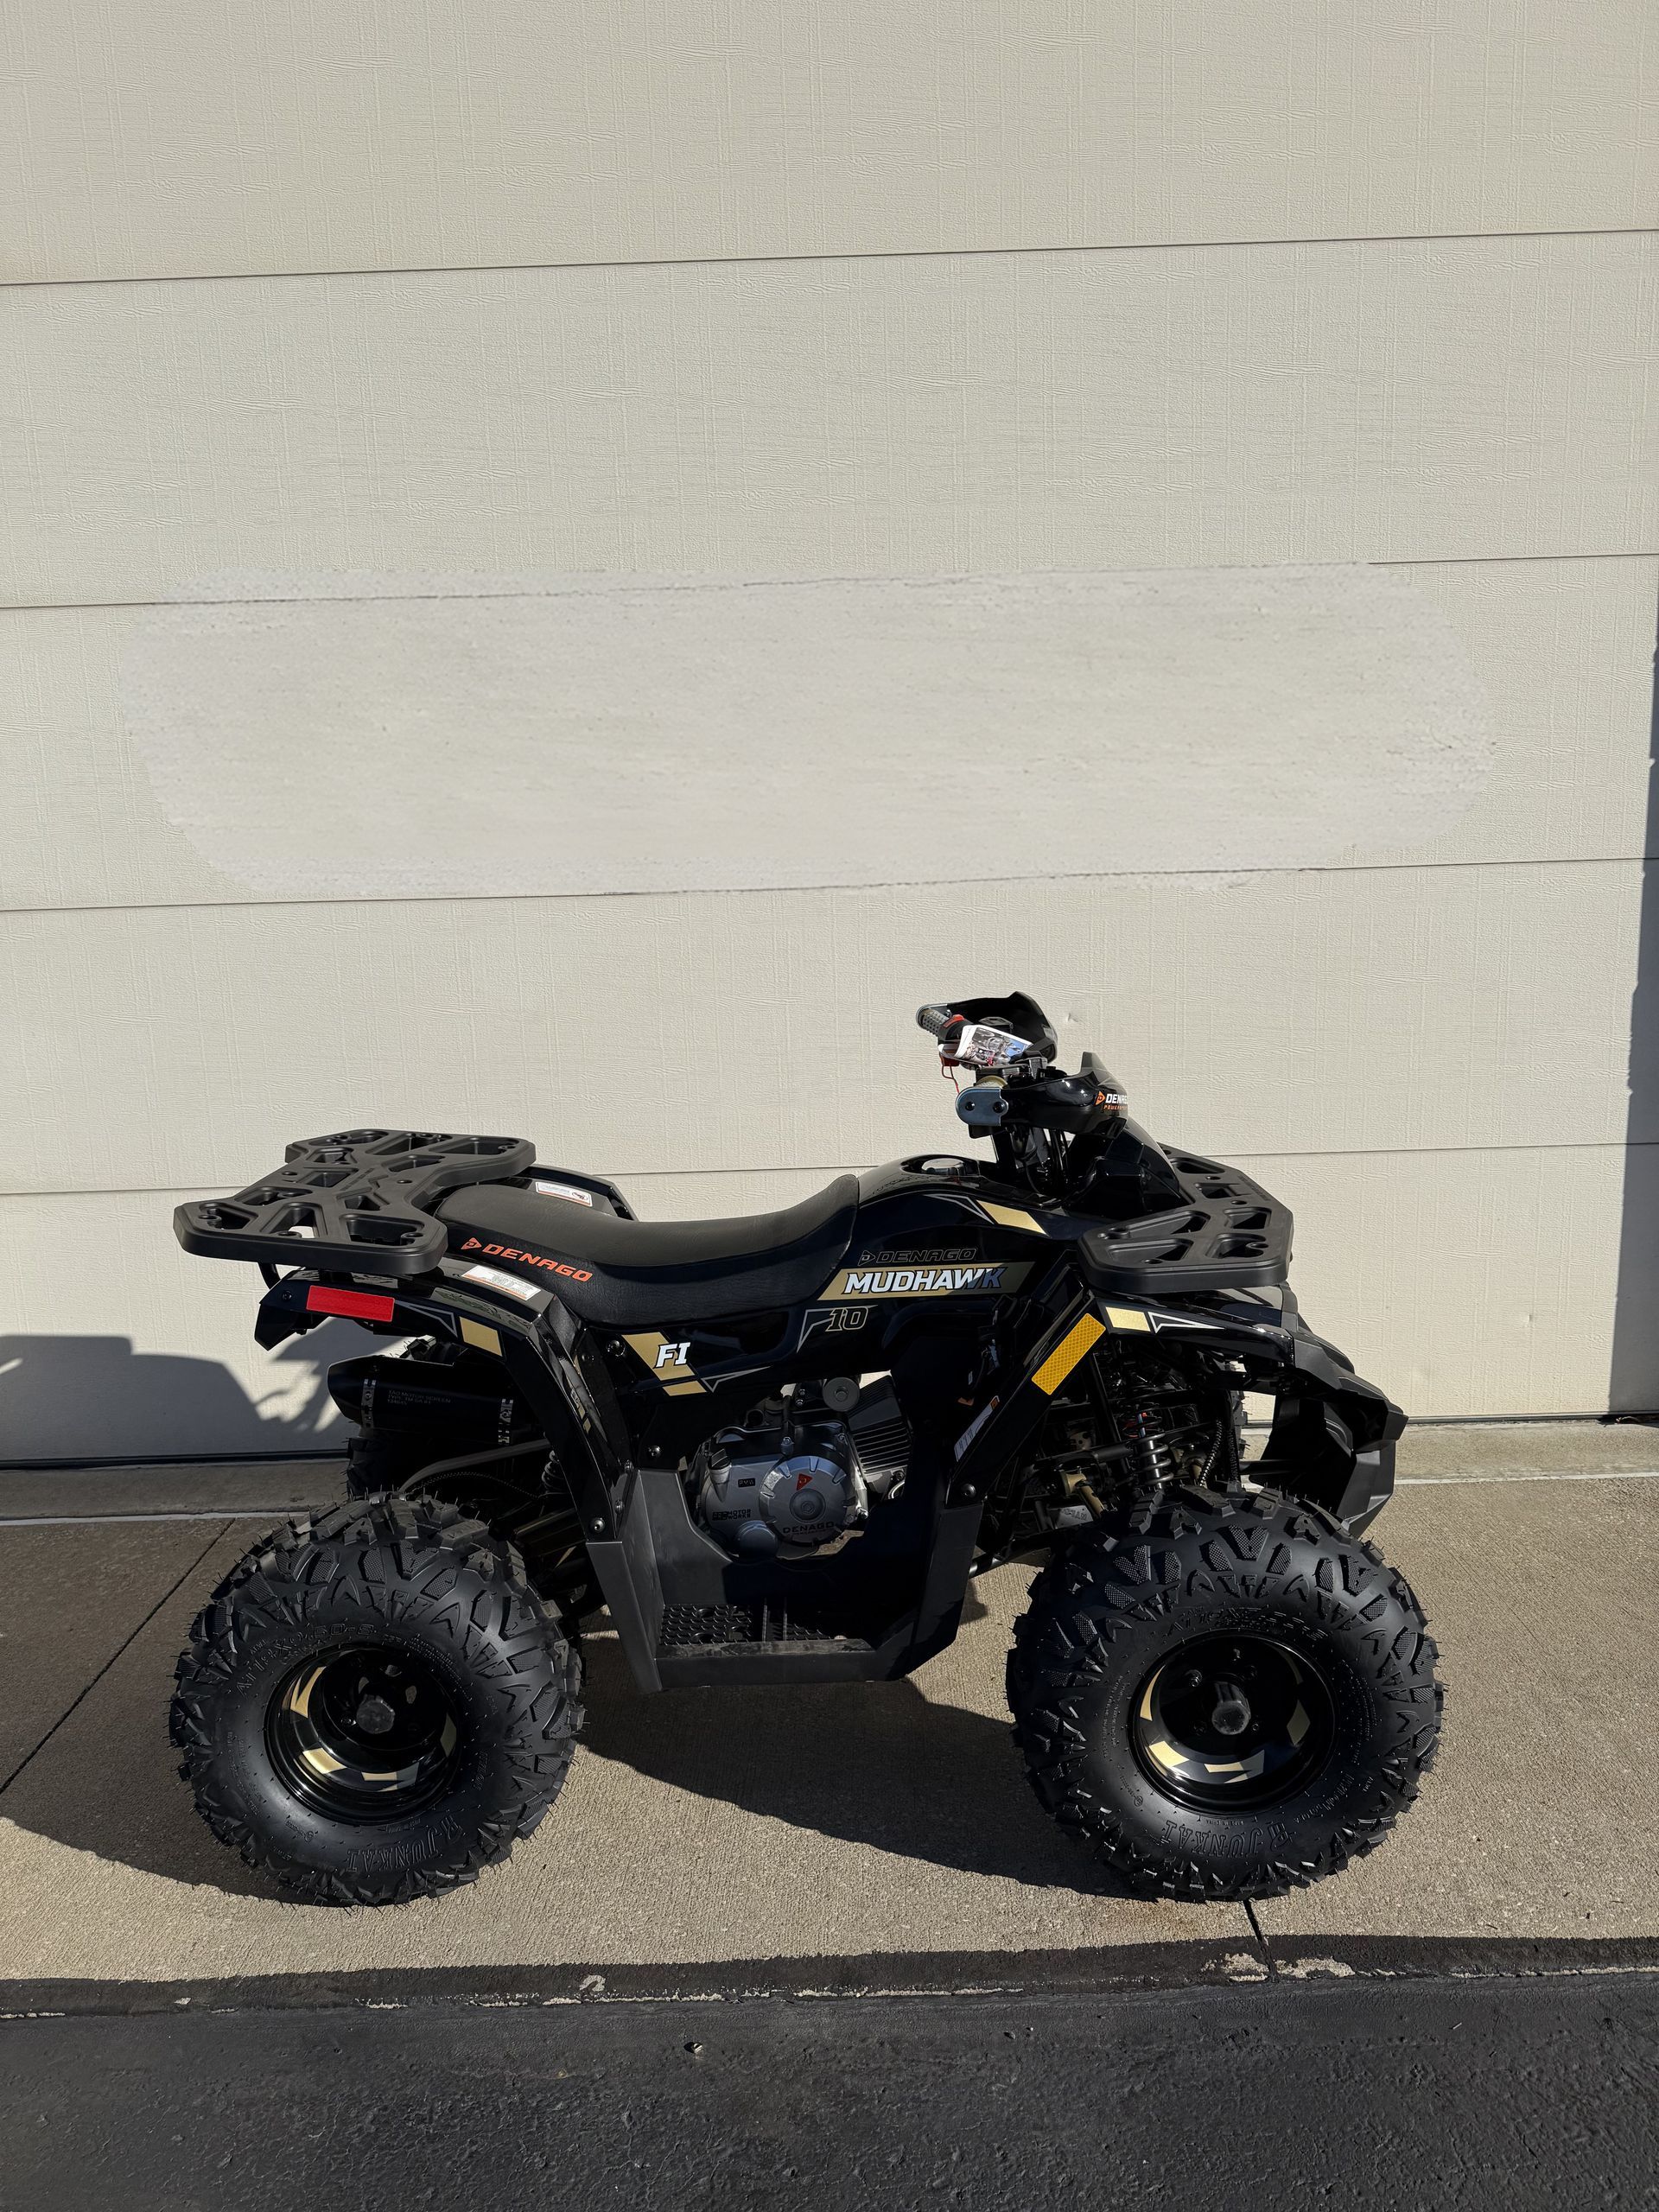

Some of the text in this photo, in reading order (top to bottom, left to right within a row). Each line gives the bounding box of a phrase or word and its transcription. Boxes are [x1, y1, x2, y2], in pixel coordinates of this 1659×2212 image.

[482, 1243, 594, 1282] DENAGO
[875, 1248, 977, 1264] DENAGO
[842, 1267, 1008, 1294] MUDHAWK
[825, 1306, 868, 1332] 10
[652, 1342, 691, 1369] FI
[783, 1521, 835, 1534] DENAGO
[346, 1827, 442, 1874] JUNKAI
